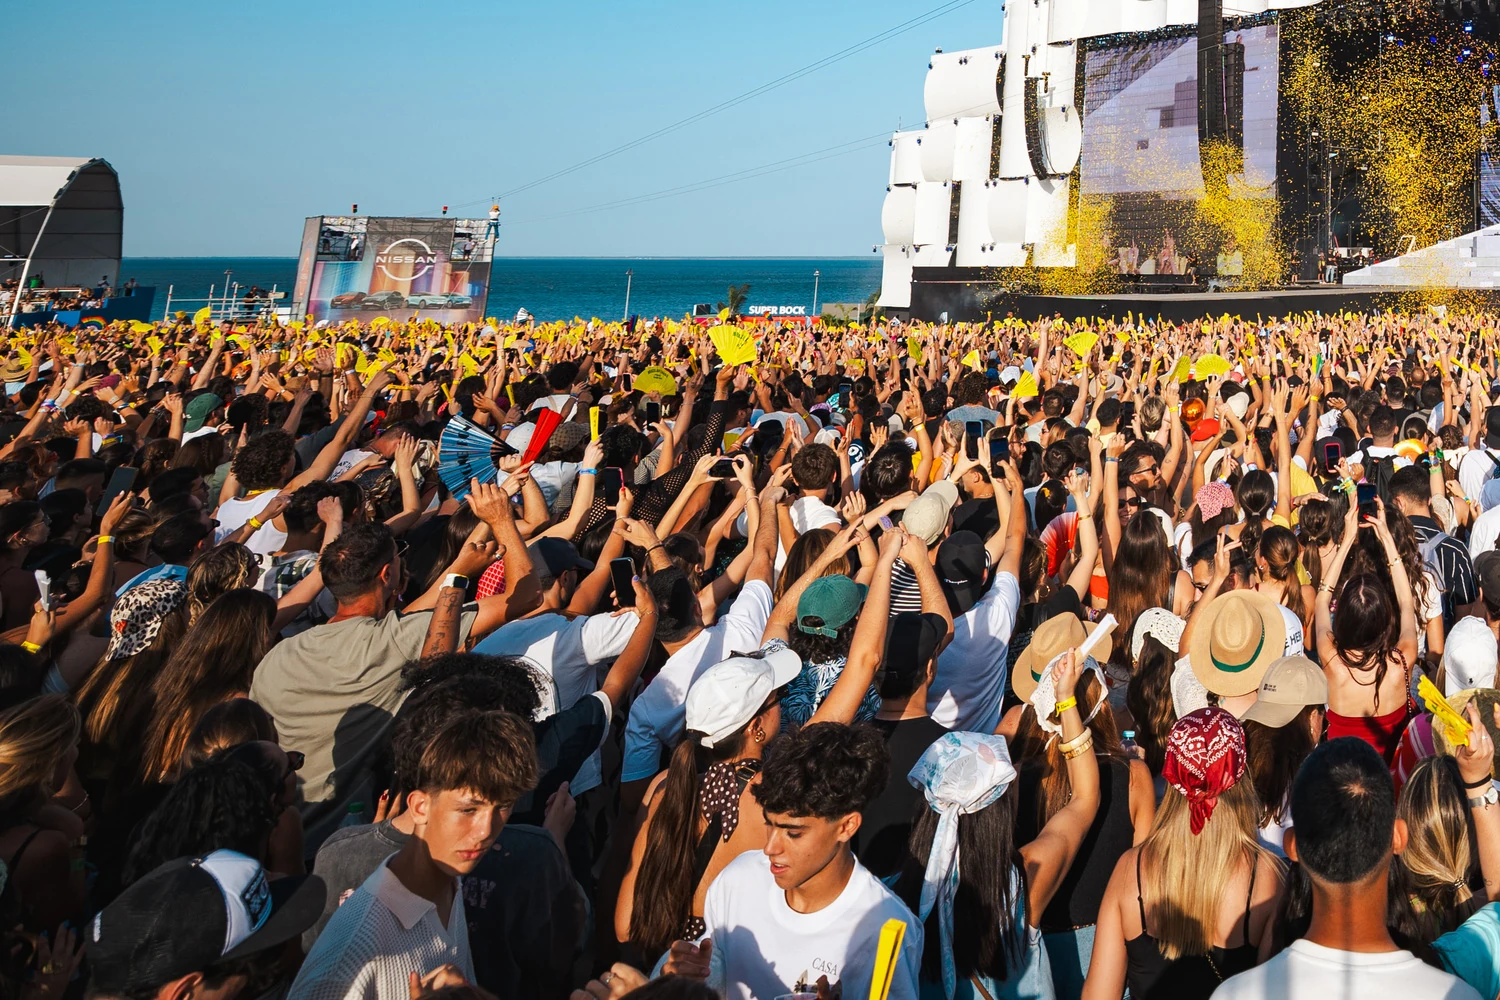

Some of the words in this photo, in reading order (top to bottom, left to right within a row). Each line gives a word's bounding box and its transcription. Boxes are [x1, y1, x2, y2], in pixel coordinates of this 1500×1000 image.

[376, 256, 436, 264] NISSAN
[748, 306, 778, 314] SUPER
[779, 306, 805, 314] BOCK
[812, 957, 838, 976] CASA
